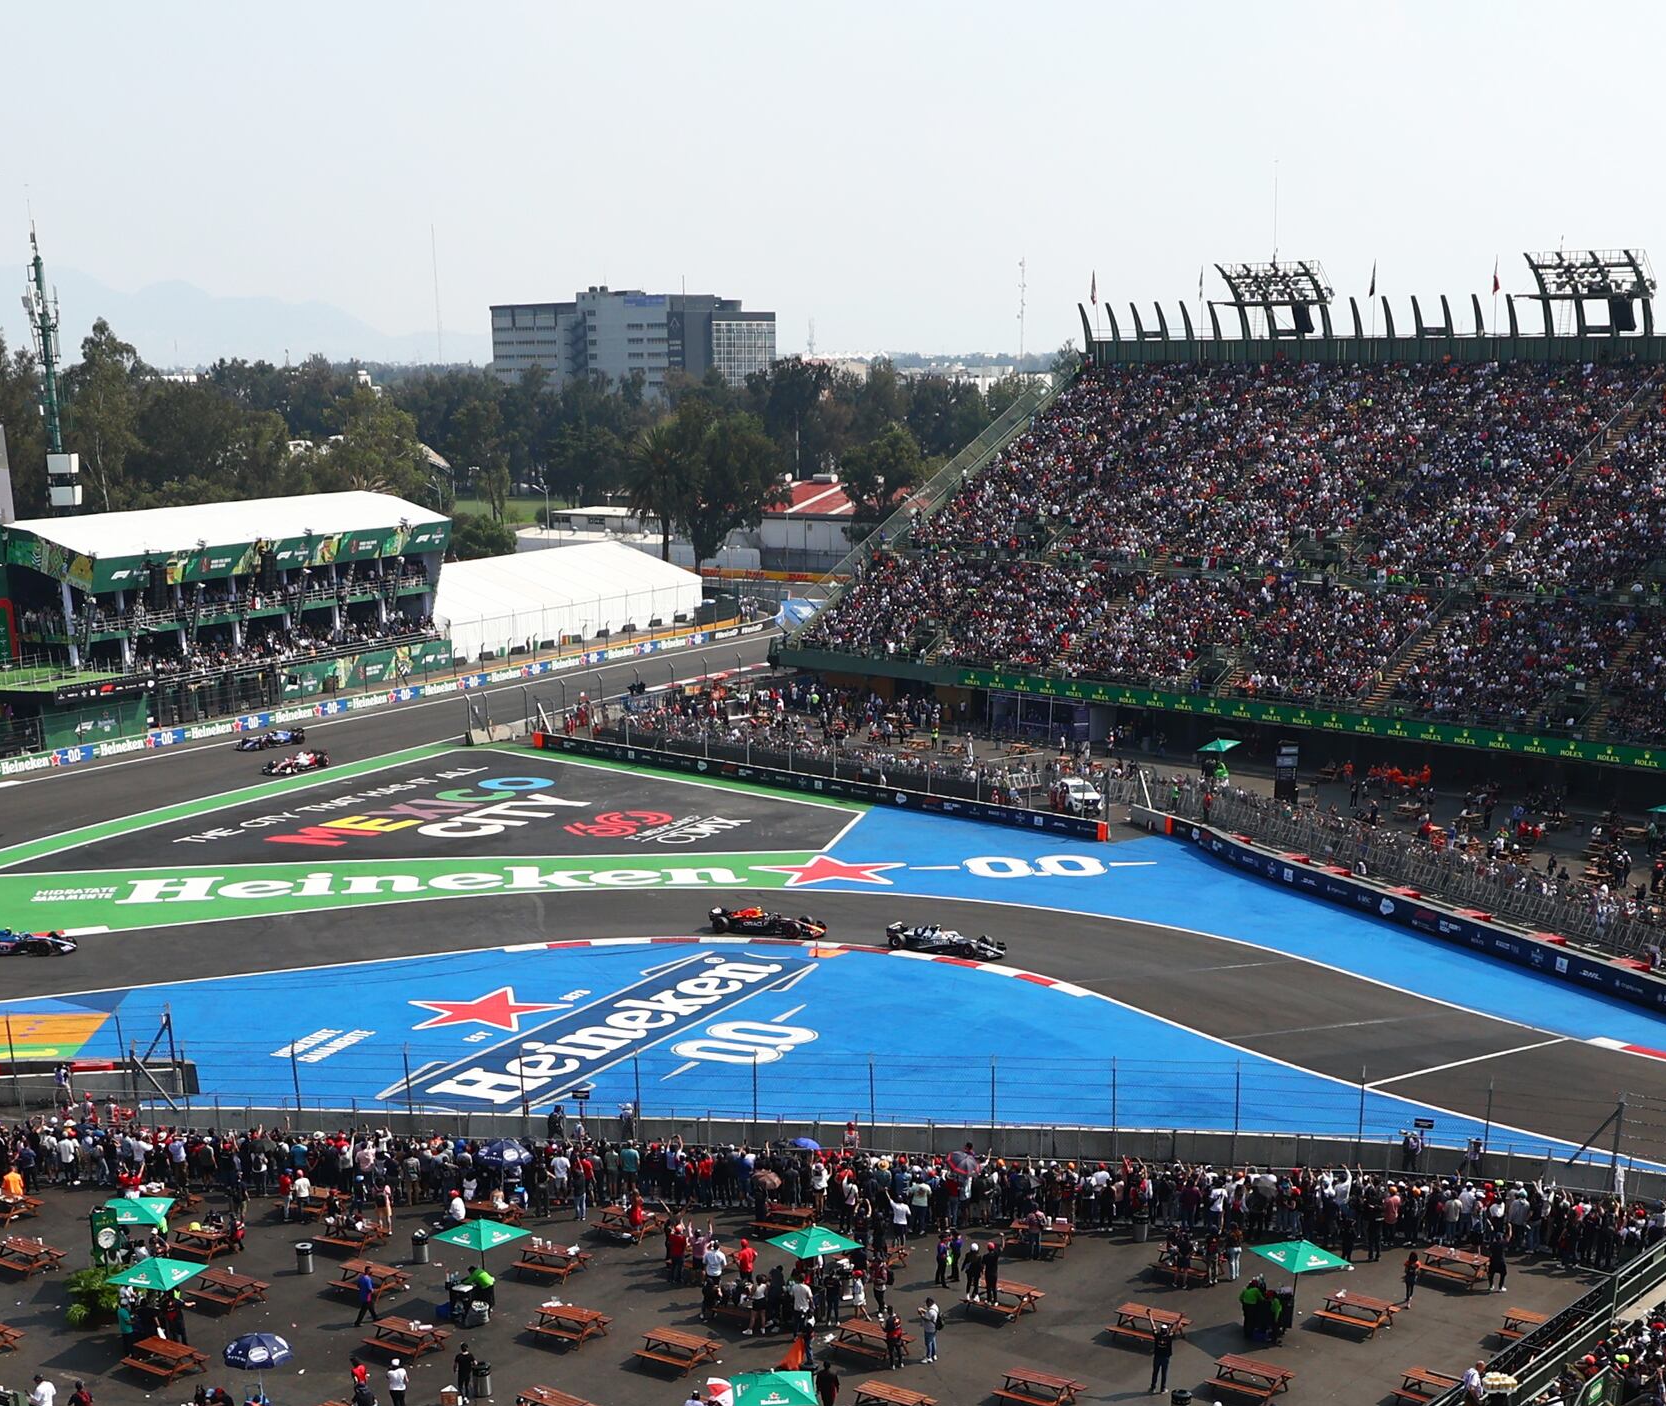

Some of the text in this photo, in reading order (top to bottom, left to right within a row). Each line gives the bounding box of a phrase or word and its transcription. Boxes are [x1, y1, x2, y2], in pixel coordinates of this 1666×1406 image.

[425, 681, 457, 695] Heineken
[353, 694, 387, 709] Heineken
[275, 708, 313, 724] Heineken
[1292, 718, 1312, 726] ROLEX
[191, 722, 233, 739] Heineken
[1323, 721, 1343, 729] ROLEX
[1355, 725, 1375, 733] ROLEX
[1387, 729, 1408, 737] ROLEX
[1420, 732, 1441, 741] ROLEX
[1454, 736, 1475, 745] ROLEX
[1489, 741, 1511, 750] ROLEX
[101, 738, 145, 756] Heineken
[1524, 745, 1546, 754] ROLEX
[1560, 749, 1583, 758] ROLEX
[1597, 754, 1620, 763] ROLEX
[1, 757, 50, 775] Heineken
[1635, 758, 1659, 767] ROLEX
[172, 765, 489, 844] THE CITY THAT HAS IT ALL
[263, 776, 556, 847] MEXICO
[417, 793, 592, 838] CITY
[656, 815, 752, 844] CDMX
[113, 854, 1108, 905] Heineken 0.0
[31, 892, 113, 902] SANAMENTE
[35, 886, 118, 896] HIDRATATE
[428, 955, 785, 1103] Heineken
[670, 1020, 819, 1065] 0.0
